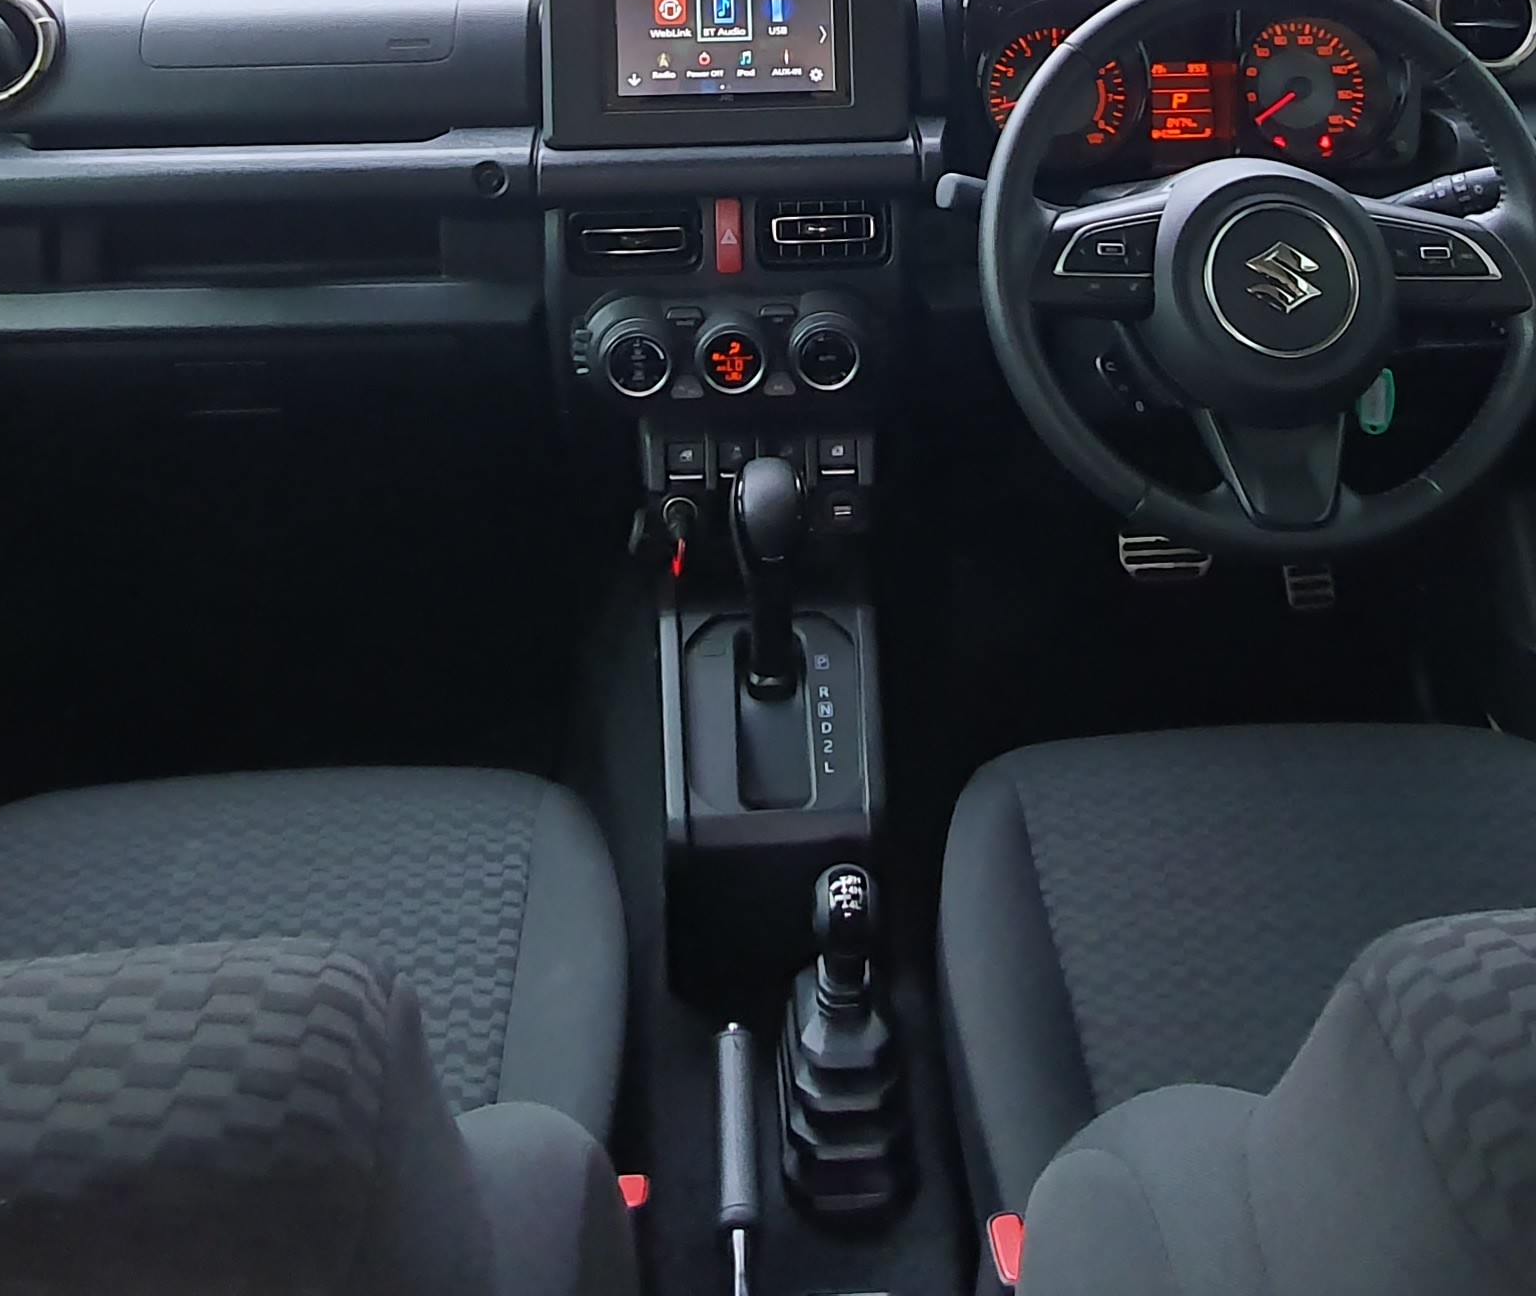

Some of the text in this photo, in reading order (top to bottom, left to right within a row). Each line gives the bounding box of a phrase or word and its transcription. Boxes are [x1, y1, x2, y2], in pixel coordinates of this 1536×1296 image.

[650, 28, 692, 38] WebLink
[703, 27, 747, 37] BT Audio
[768, 26, 788, 35] USB
[652, 71, 677, 79] Radio
[736, 69, 755, 77] iPod
[772, 68, 802, 76] AUX-IN
[1171, 93, 1188, 109] P
[819, 686, 829, 698] R
[820, 704, 831, 716] N
[821, 721, 832, 734] D
[823, 739, 833, 753] 2
[824, 761, 835, 773] L
